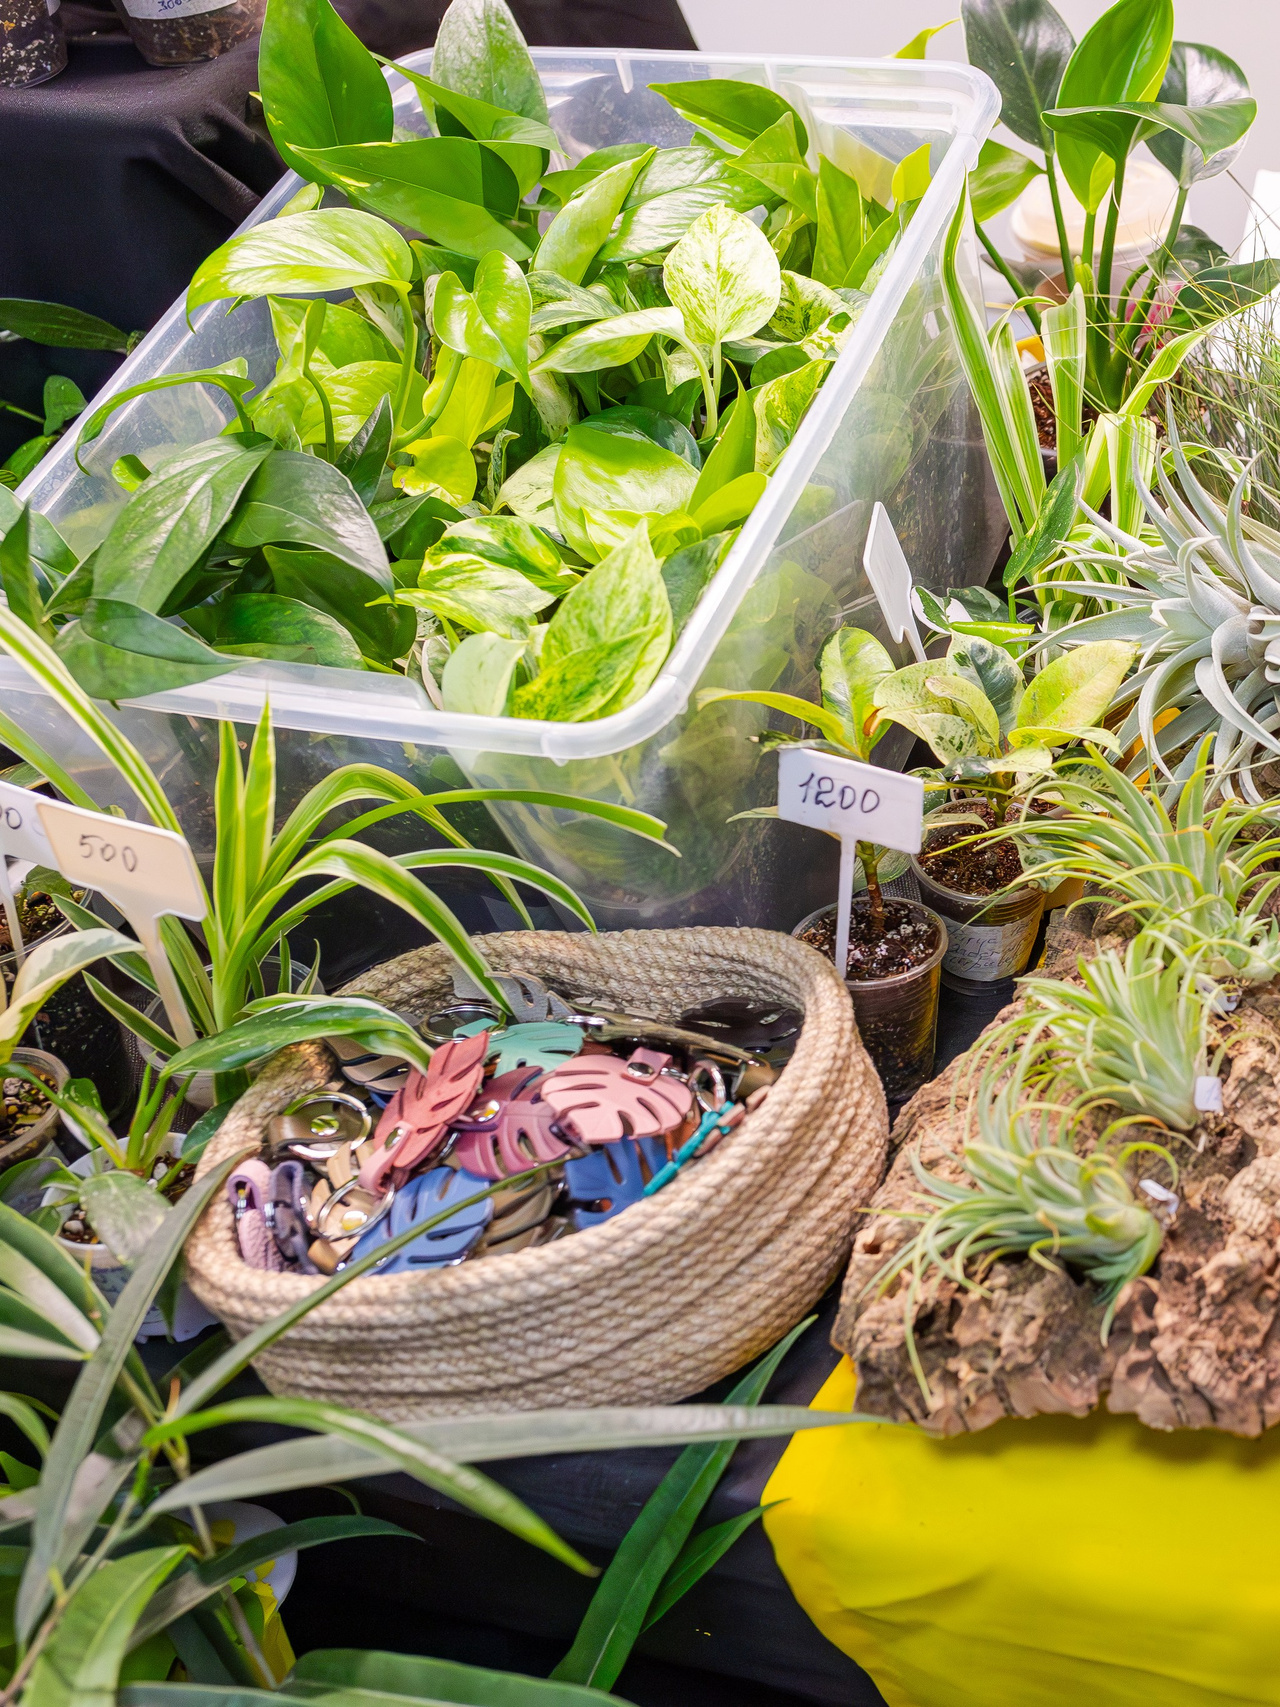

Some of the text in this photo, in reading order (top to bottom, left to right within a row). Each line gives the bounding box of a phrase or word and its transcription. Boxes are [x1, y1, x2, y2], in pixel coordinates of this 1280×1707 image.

[799, 772, 880, 813] 1200
[0, 806, 22, 829] 0
[80, 834, 137, 872] 500
